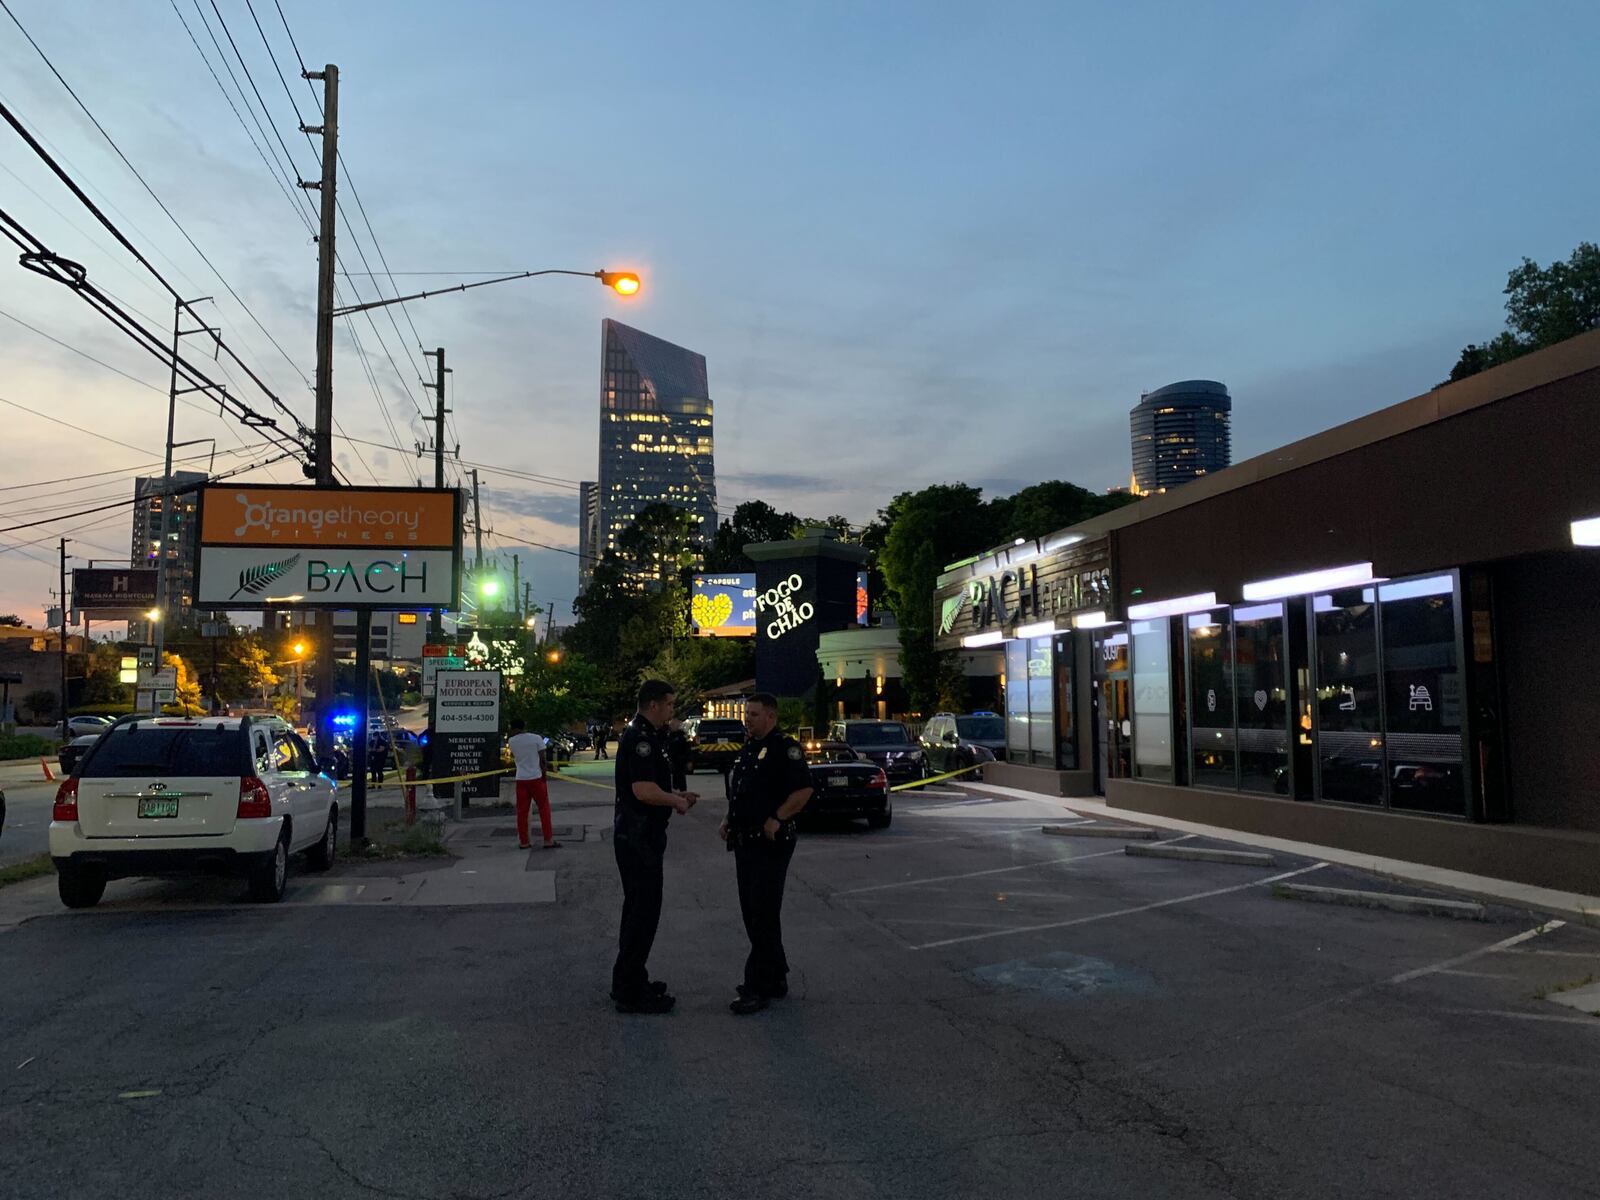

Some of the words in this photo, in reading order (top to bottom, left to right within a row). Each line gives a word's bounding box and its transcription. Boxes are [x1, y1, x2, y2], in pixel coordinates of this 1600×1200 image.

[271, 530, 418, 540] FITNESS
[112, 576, 128, 591] H
[307, 560, 427, 593] BACH
[756, 574, 802, 612] FOGO
[970, 563, 1038, 628] BACH
[774, 596, 794, 617] DE
[445, 679, 493, 687] EUROPEAN
[440, 688, 473, 697] MOTOR
[475, 688, 497, 697] CARS
[441, 714, 495, 722] 404-554-4300
